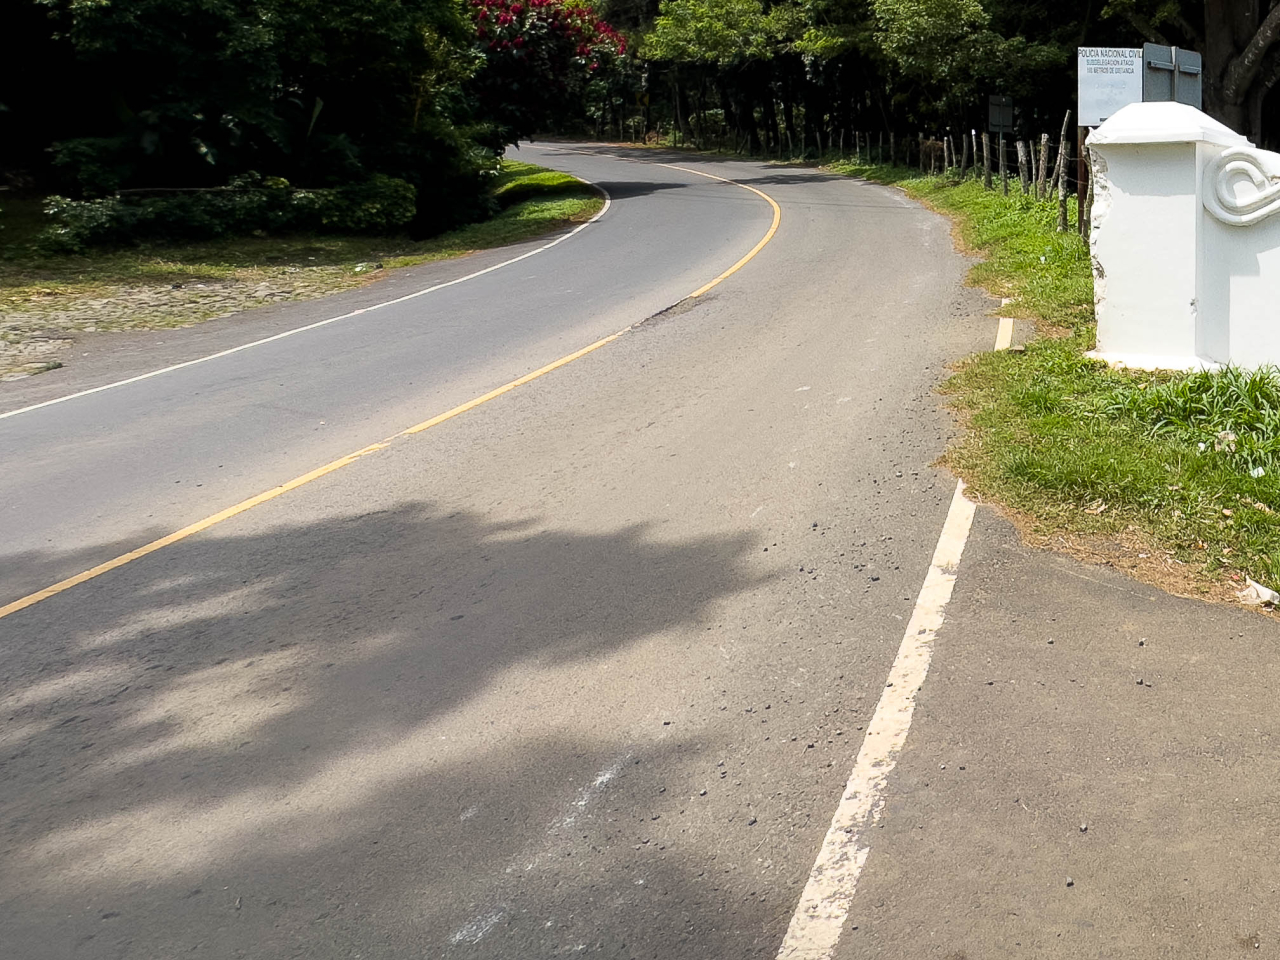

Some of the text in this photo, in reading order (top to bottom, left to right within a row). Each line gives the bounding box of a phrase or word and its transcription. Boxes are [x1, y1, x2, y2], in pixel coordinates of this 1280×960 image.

[1078, 49, 1142, 58] POLICIA NACIONAL CIVIL
